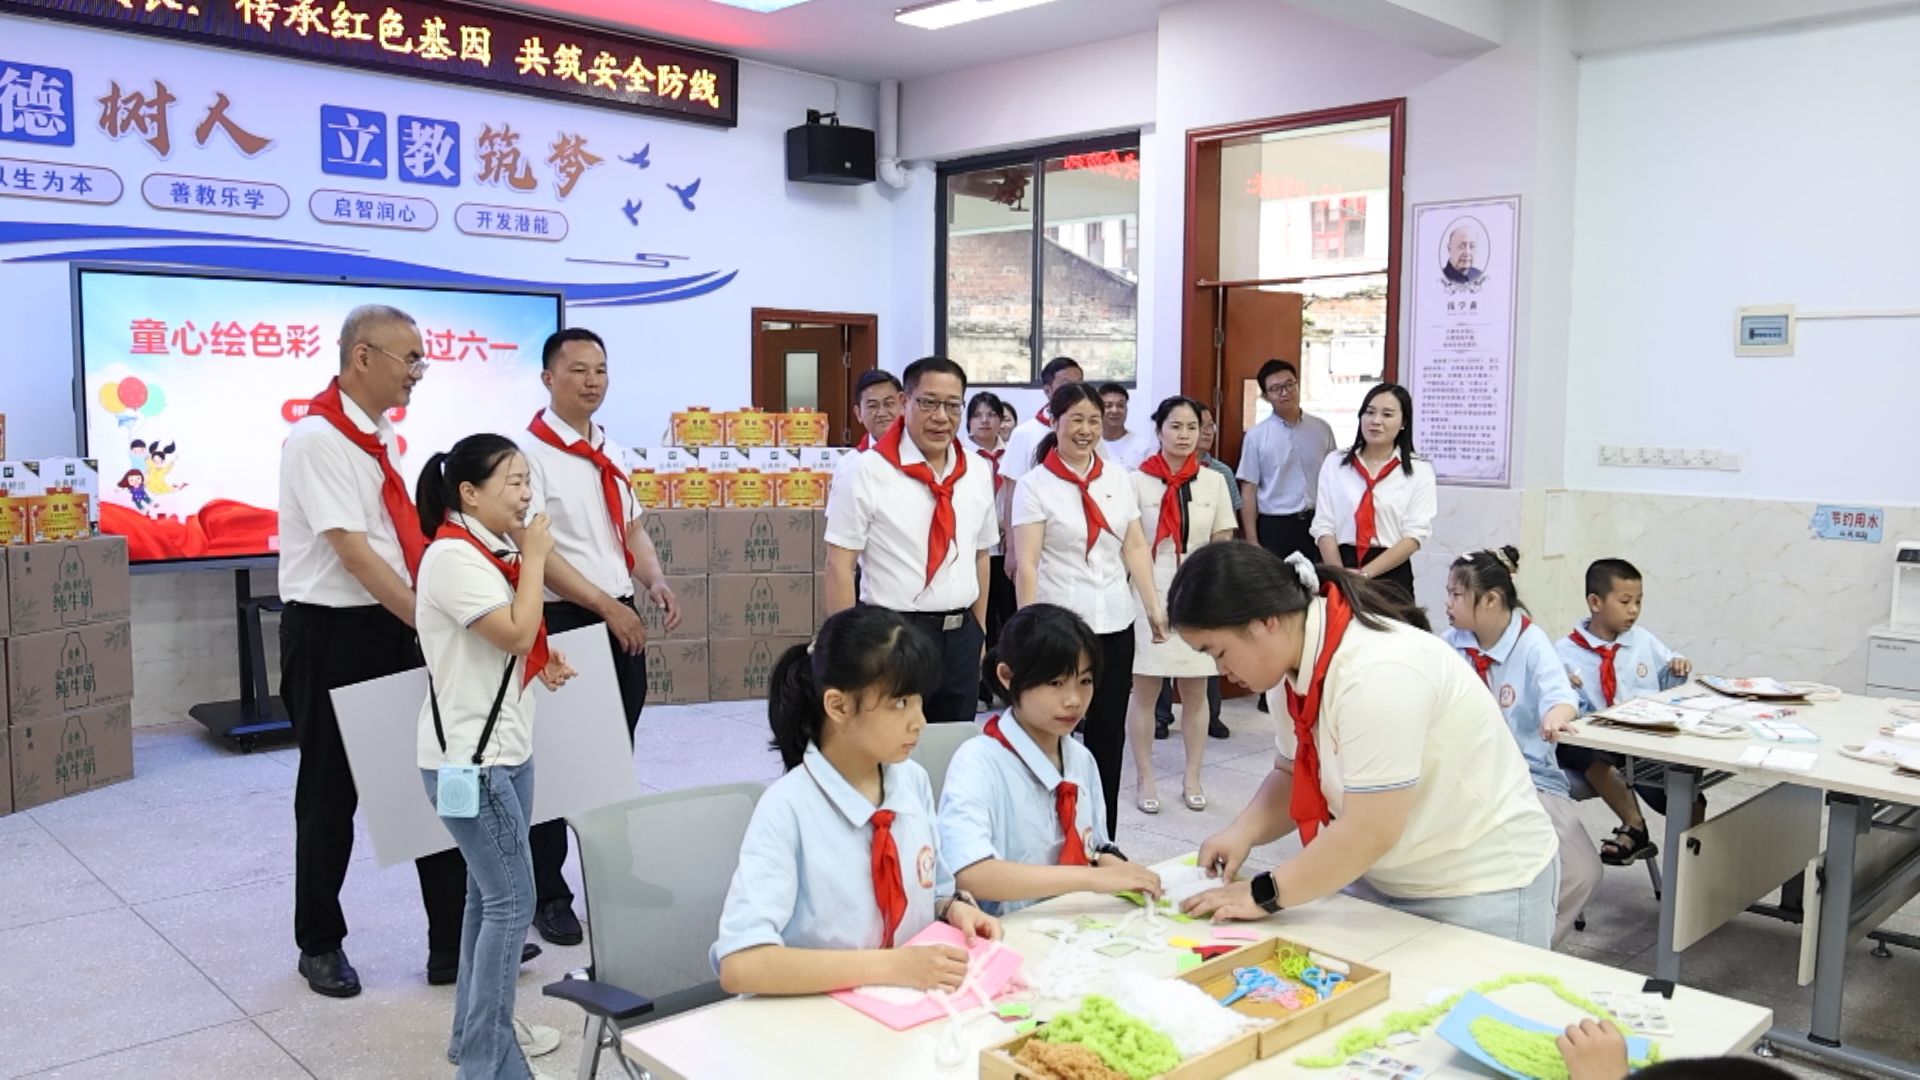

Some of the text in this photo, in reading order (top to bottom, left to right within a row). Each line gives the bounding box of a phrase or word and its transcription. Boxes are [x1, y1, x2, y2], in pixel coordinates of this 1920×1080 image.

[234, 0, 719, 108] 传承红色基因 共筑安全防线
[327, 113, 603, 198] 立教筑梦
[170, 182, 265, 209] 善教乐学
[334, 198, 416, 223] 启智润心
[476, 211, 549, 234] 开发潜能
[130, 319, 320, 359] 童心绘色彩
[1832, 511, 1879, 528] 节约用水
[53, 590, 93, 612] 纯牛奶
[55, 675, 96, 699] 纯牛奶
[55, 757, 96, 784] 纯牛奶
